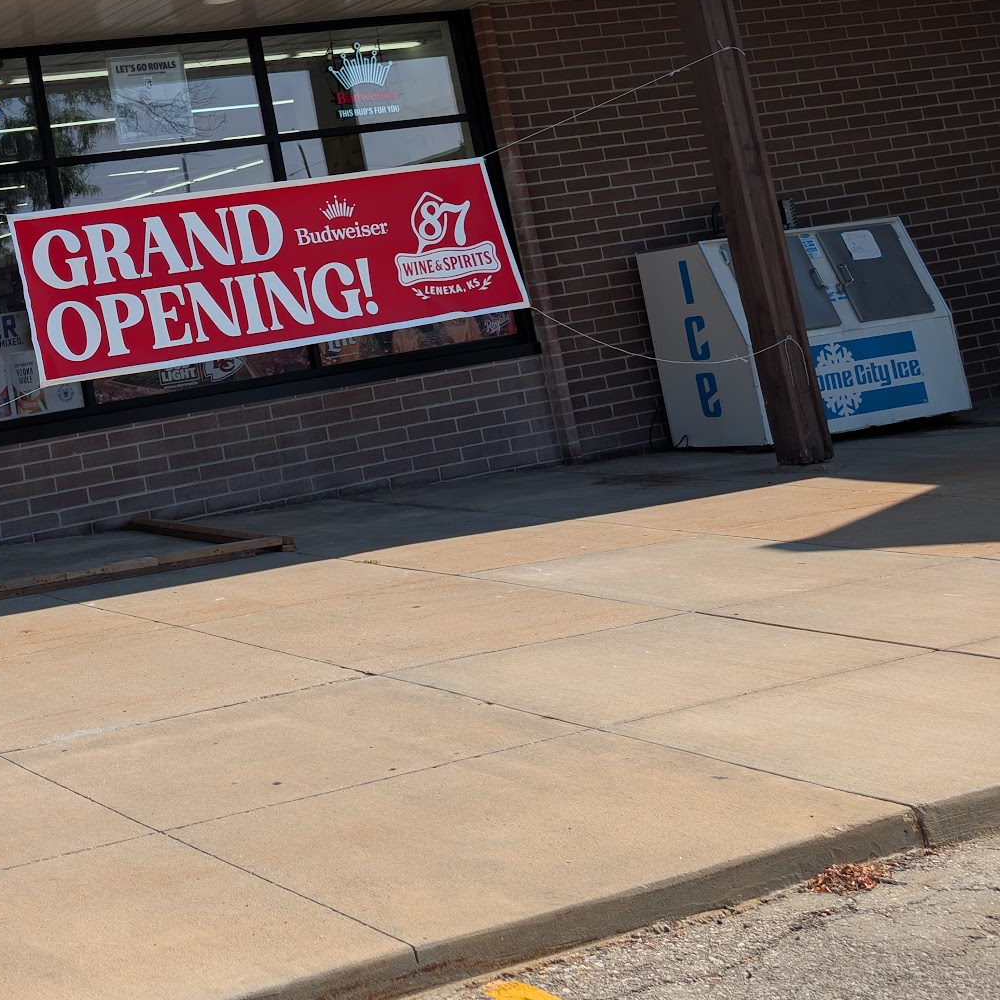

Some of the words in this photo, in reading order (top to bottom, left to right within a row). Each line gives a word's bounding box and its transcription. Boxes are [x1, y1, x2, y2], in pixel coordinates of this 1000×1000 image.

[115, 63, 136, 74] LET'S
[136, 62, 148, 72] GO
[148, 60, 177, 71] ROYALS
[335, 89, 398, 105] Budweiser
[338, 109, 354, 118] THIS
[354, 106, 374, 116] BUD'S
[374, 105, 387, 115] FOR
[386, 104, 400, 113] YOU
[418, 200, 471, 246] 87
[294, 221, 388, 246] Budweiser
[32, 203, 284, 290] GRAND
[424, 283, 467, 296] LENEXA,
[466, 277, 481, 290] KS
[47, 257, 379, 362] OPENING!
[0, 337, 24, 348] MIXED.
[160, 367, 196, 382] LIGHT
[816, 370, 854, 392] ome
[854, 362, 892, 386] City
[890, 359, 921, 379] Ice
